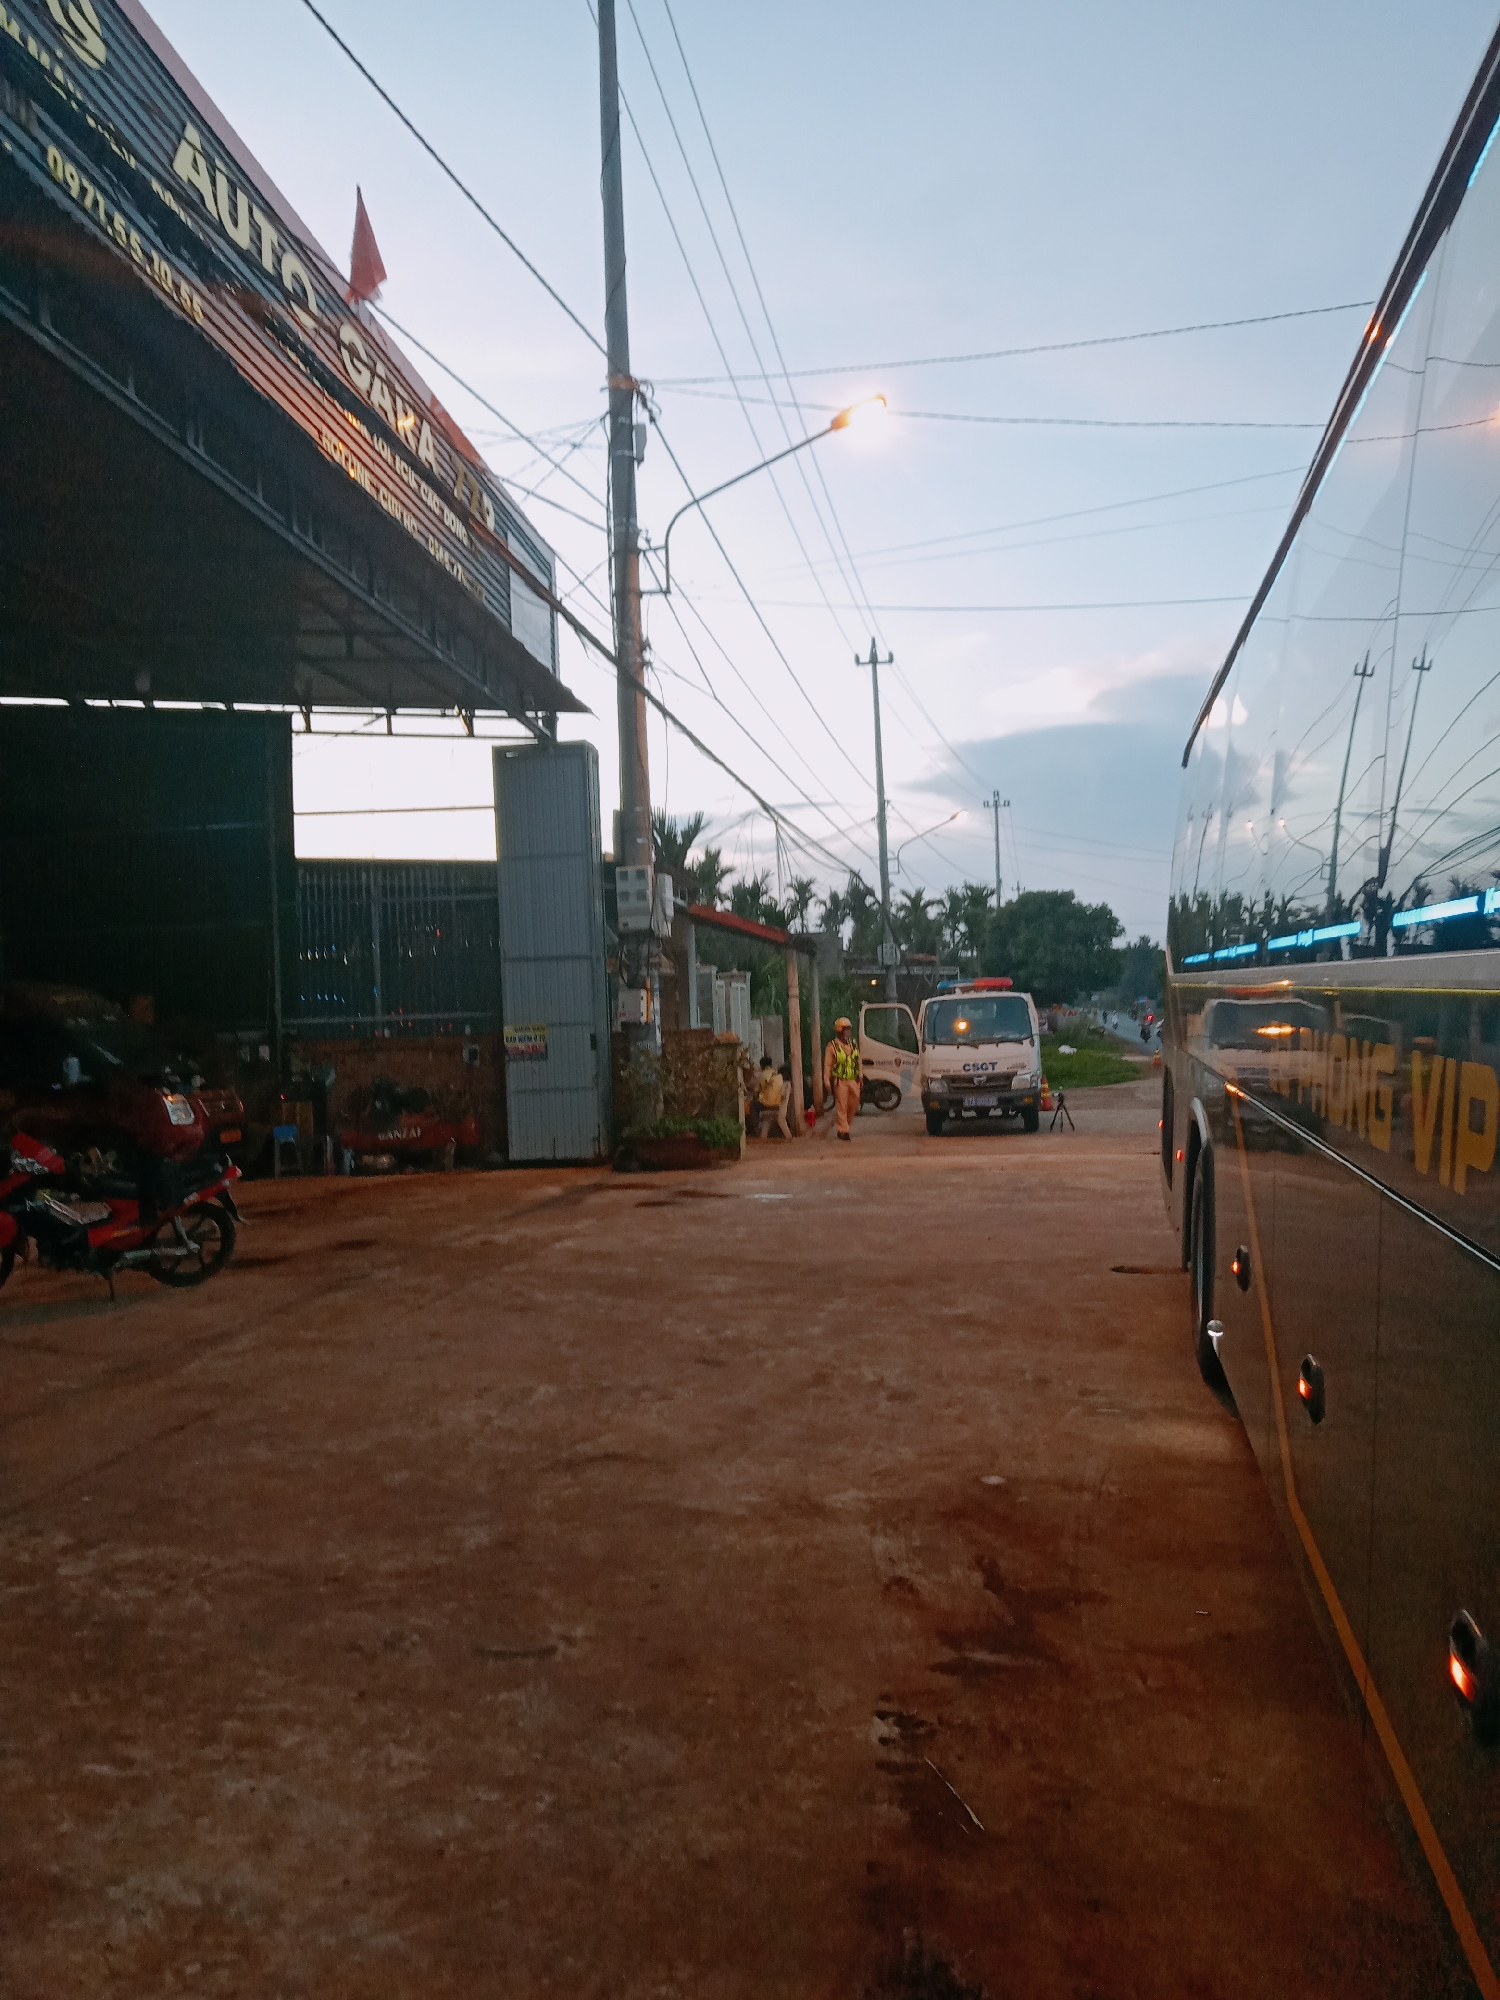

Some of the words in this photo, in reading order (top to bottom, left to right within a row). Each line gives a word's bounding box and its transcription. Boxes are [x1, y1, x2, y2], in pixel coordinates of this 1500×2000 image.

[171, 121, 318, 331] AUTO
[963, 1061, 998, 1073] CSGT
[1411, 1048, 1500, 1195] VIP
